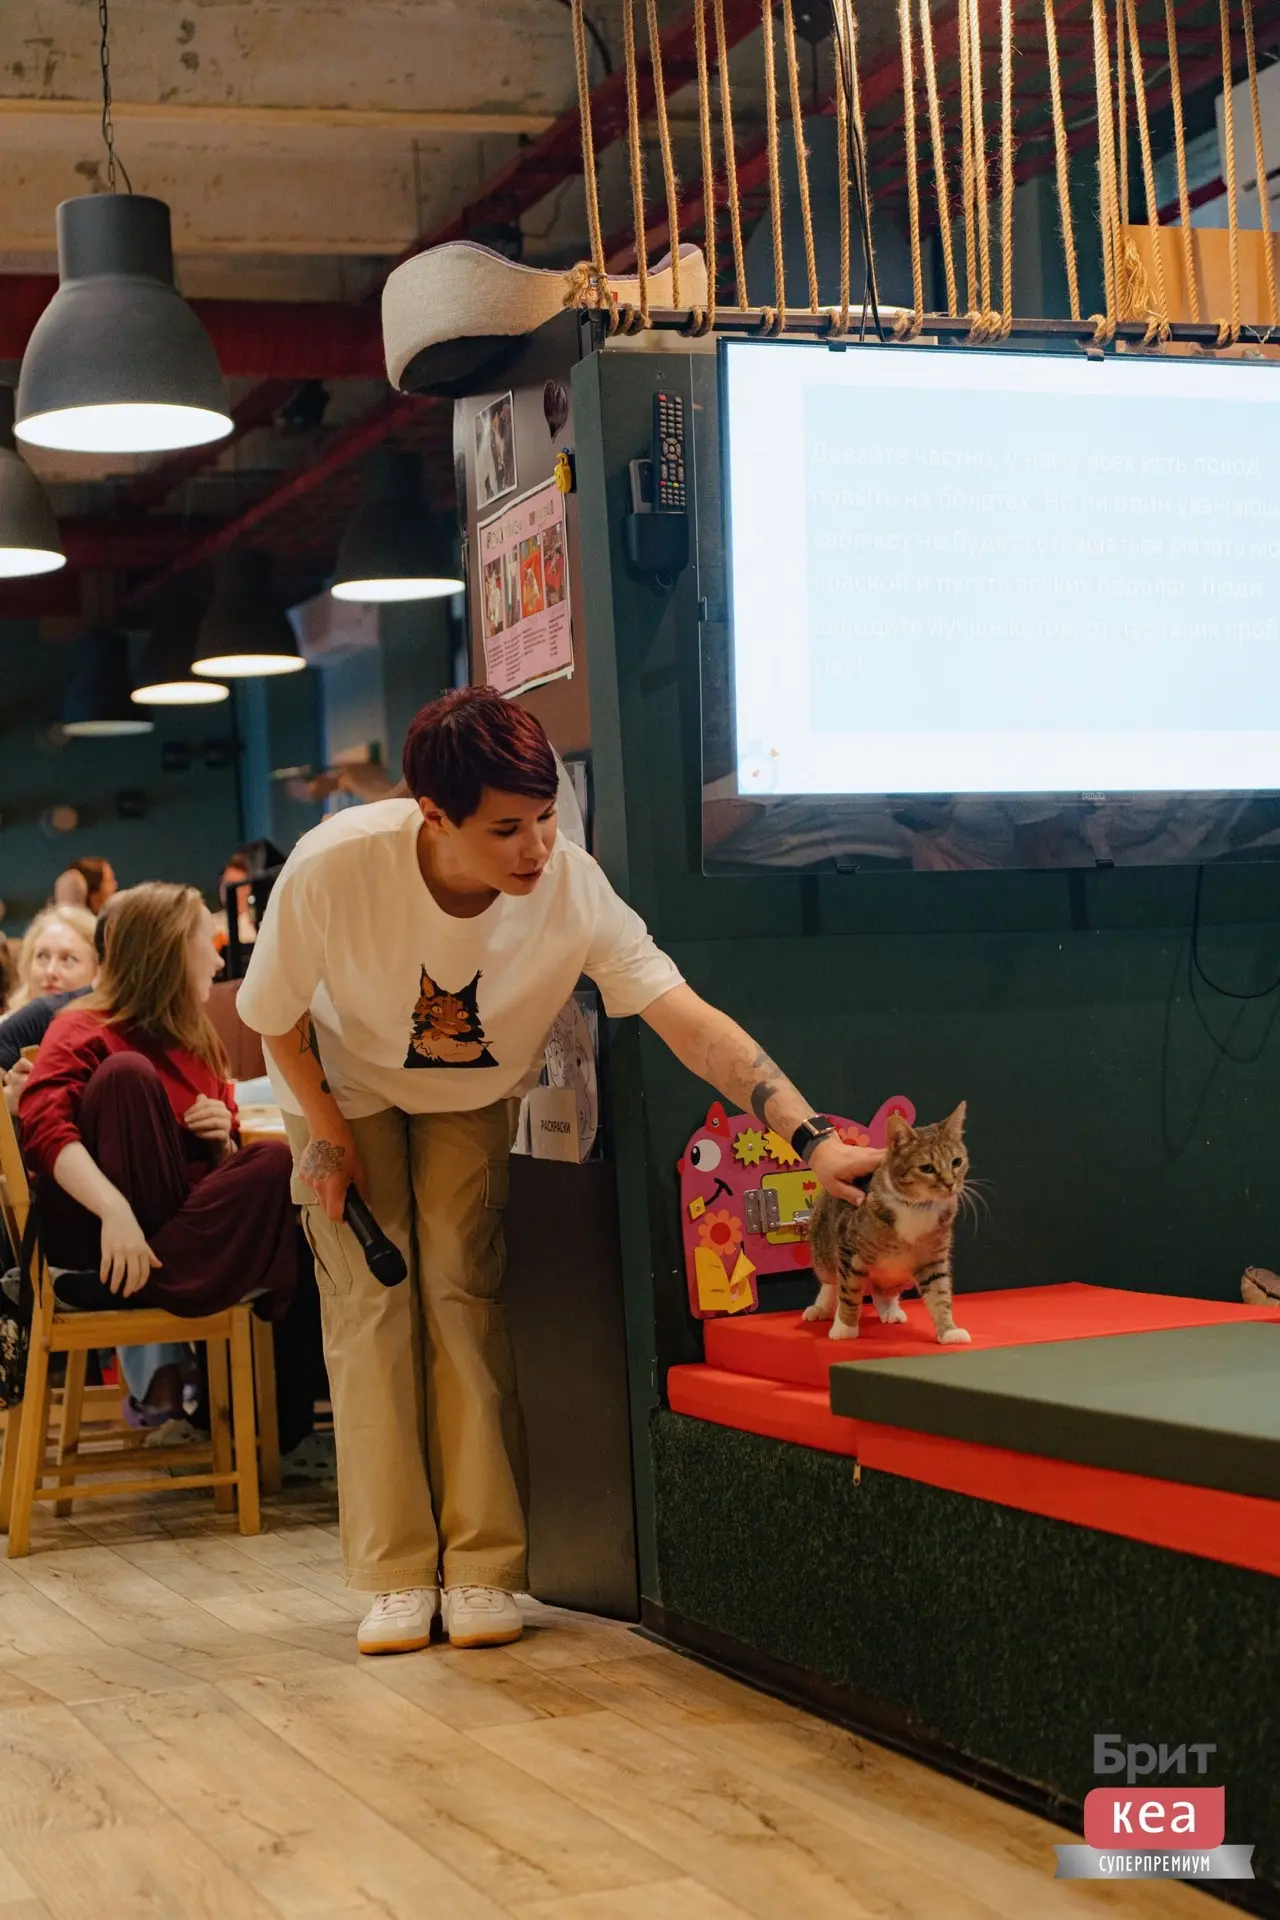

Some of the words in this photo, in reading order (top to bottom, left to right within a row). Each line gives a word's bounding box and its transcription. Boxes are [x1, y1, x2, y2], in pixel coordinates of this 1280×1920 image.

[810, 442, 909, 468] Давайте
[915, 448, 999, 472] честно,
[1006, 451, 1018, 473] у
[1025, 452, 1061, 471] нас
[1069, 455, 1080, 479] у
[1088, 454, 1135, 473] всех
[1141, 456, 1187, 474] есть
[1194, 456, 1261, 482] повод
[812, 489, 898, 510] повыть
[904, 491, 931, 510] на
[1044, 489, 1075, 514] Но
[1081, 494, 1108, 514] ни
[1115, 496, 1171, 516] один
[813, 526, 867, 550] себя
[873, 533, 910, 551] кот
[918, 534, 946, 551] не
[953, 528, 1017, 556] будет
[813, 571, 909, 594] краской
[917, 574, 930, 593] и
[937, 574, 1010, 597] пугать
[1115, 619, 1154, 639] нас
[541, 1119, 571, 1134] РАСКРАСКИ
